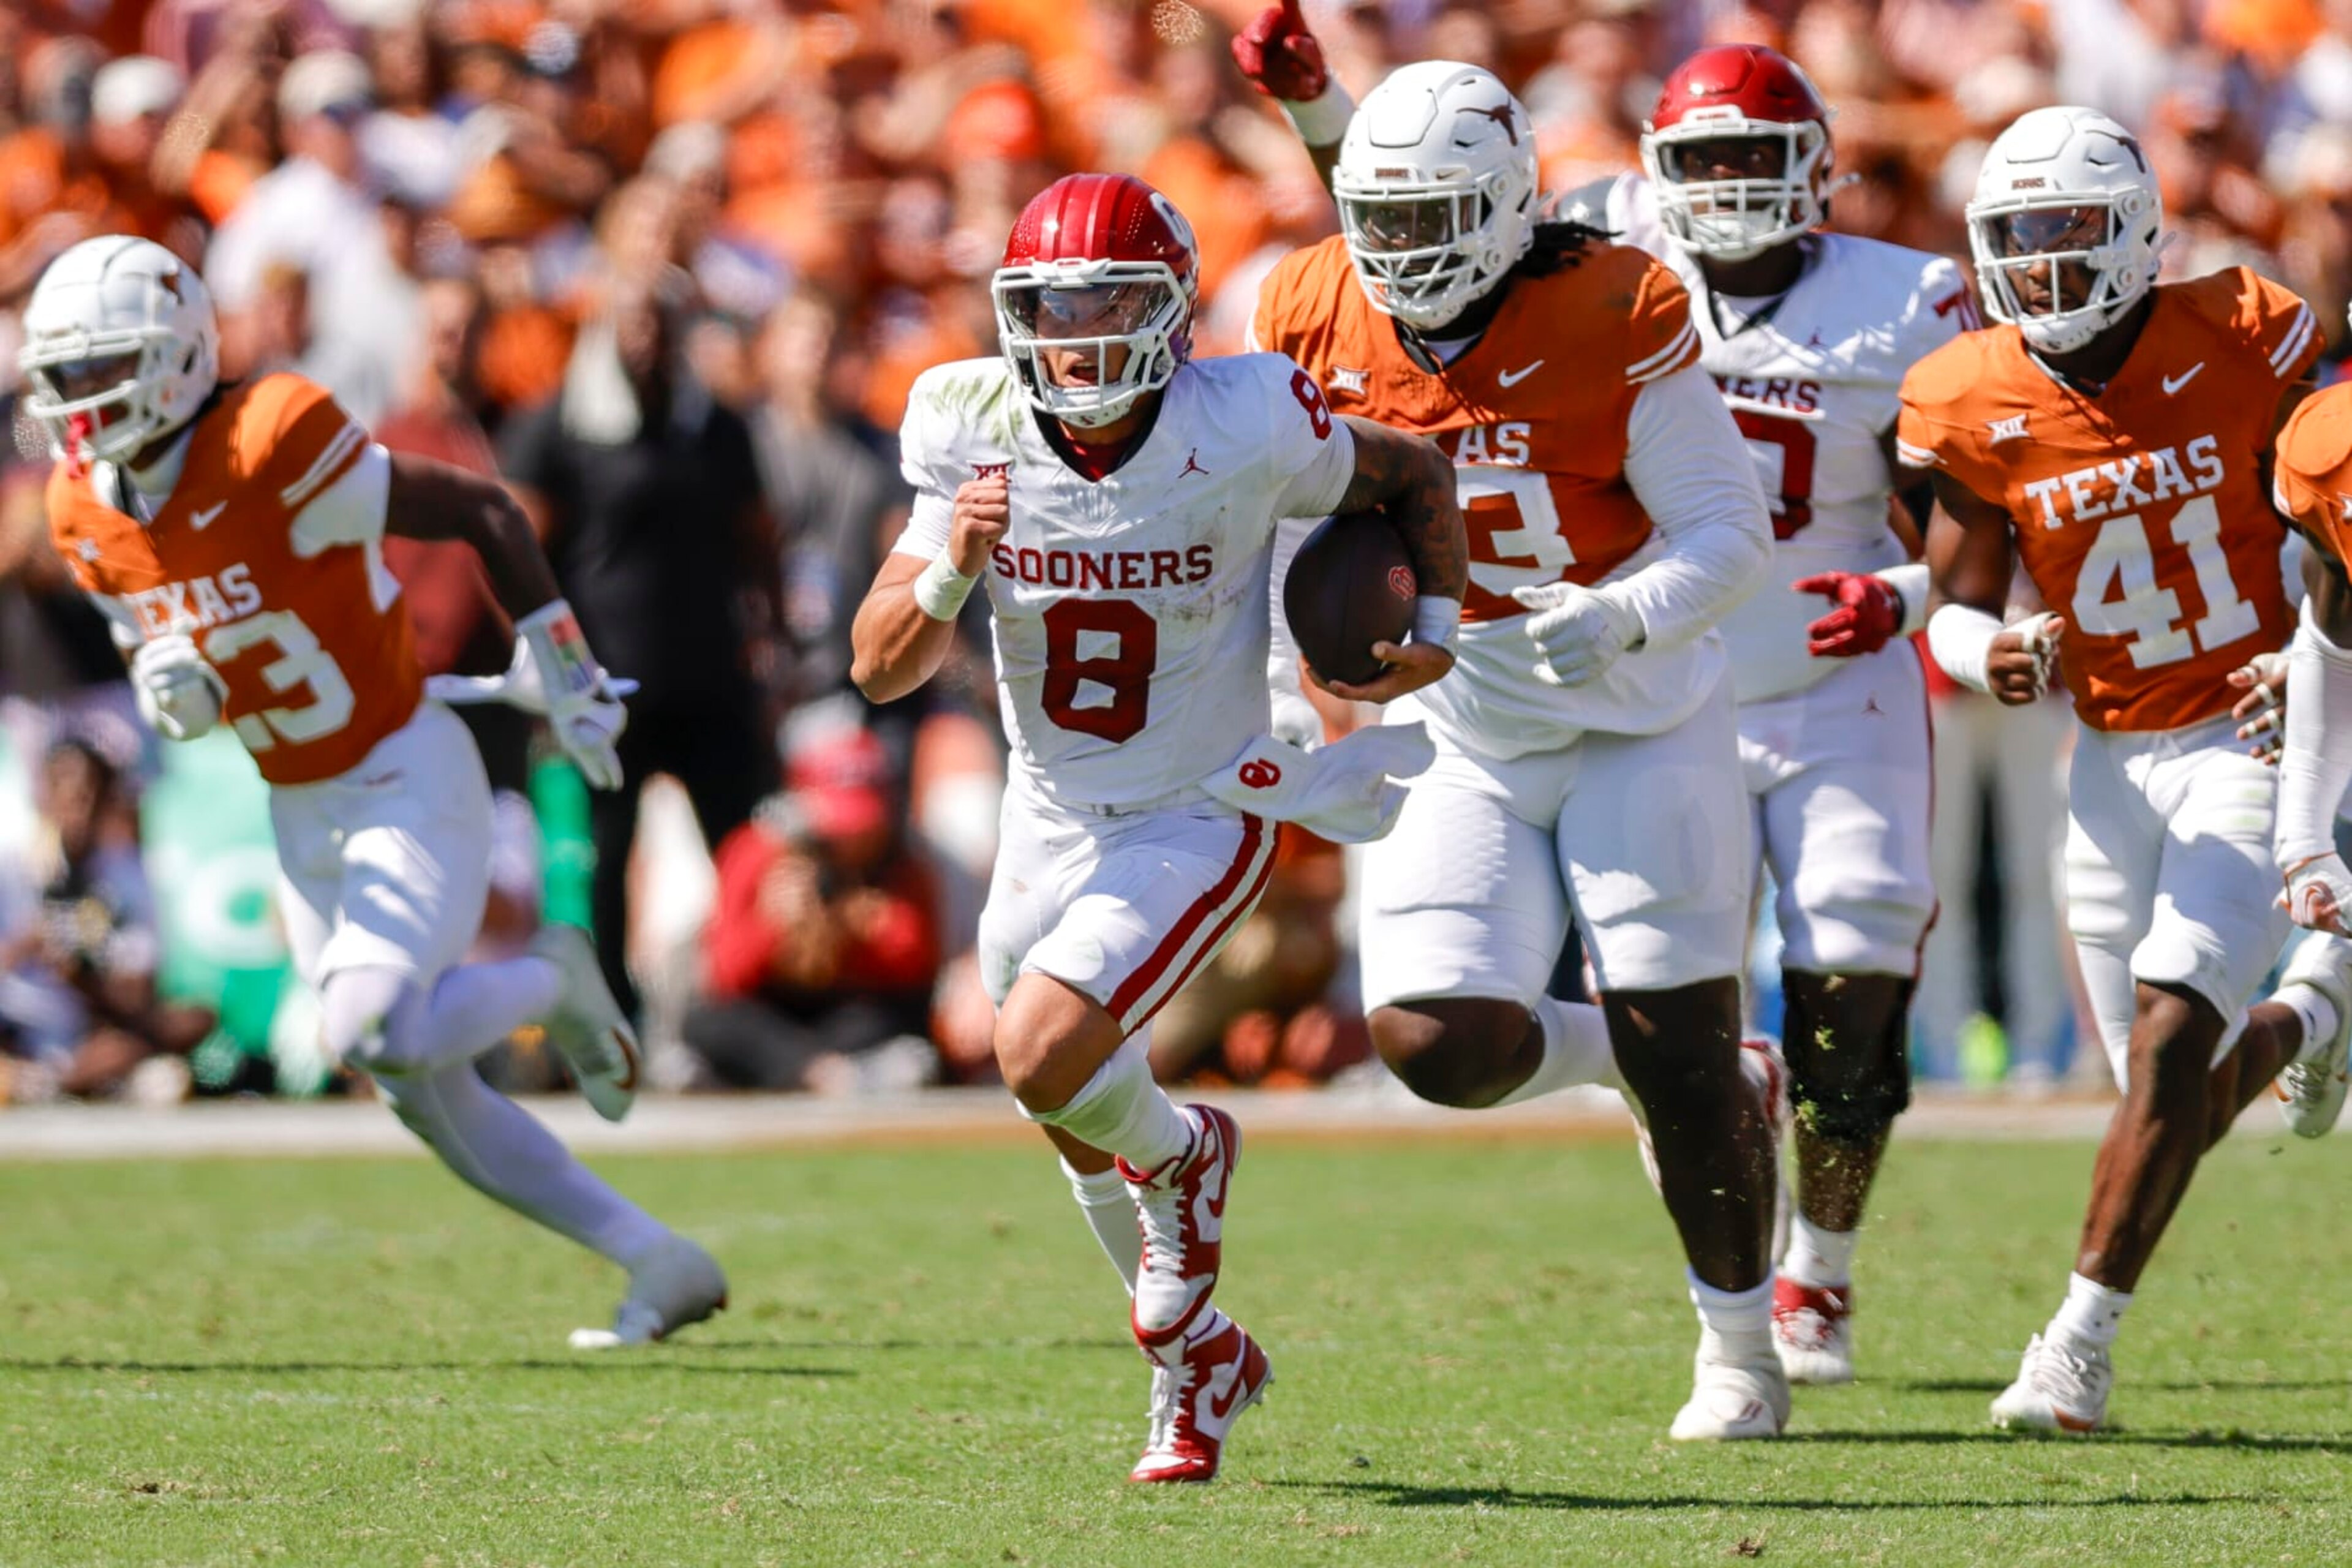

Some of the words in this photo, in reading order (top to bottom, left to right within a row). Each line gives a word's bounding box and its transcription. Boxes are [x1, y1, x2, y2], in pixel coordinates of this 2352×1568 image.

[1289, 369, 1332, 440] 8
[2024, 434, 2225, 530] TEXAS
[992, 543, 1213, 590] SOONERS
[2071, 494, 2260, 669] 41
[204, 609, 356, 752] 3
[1041, 598, 1156, 744] 8
